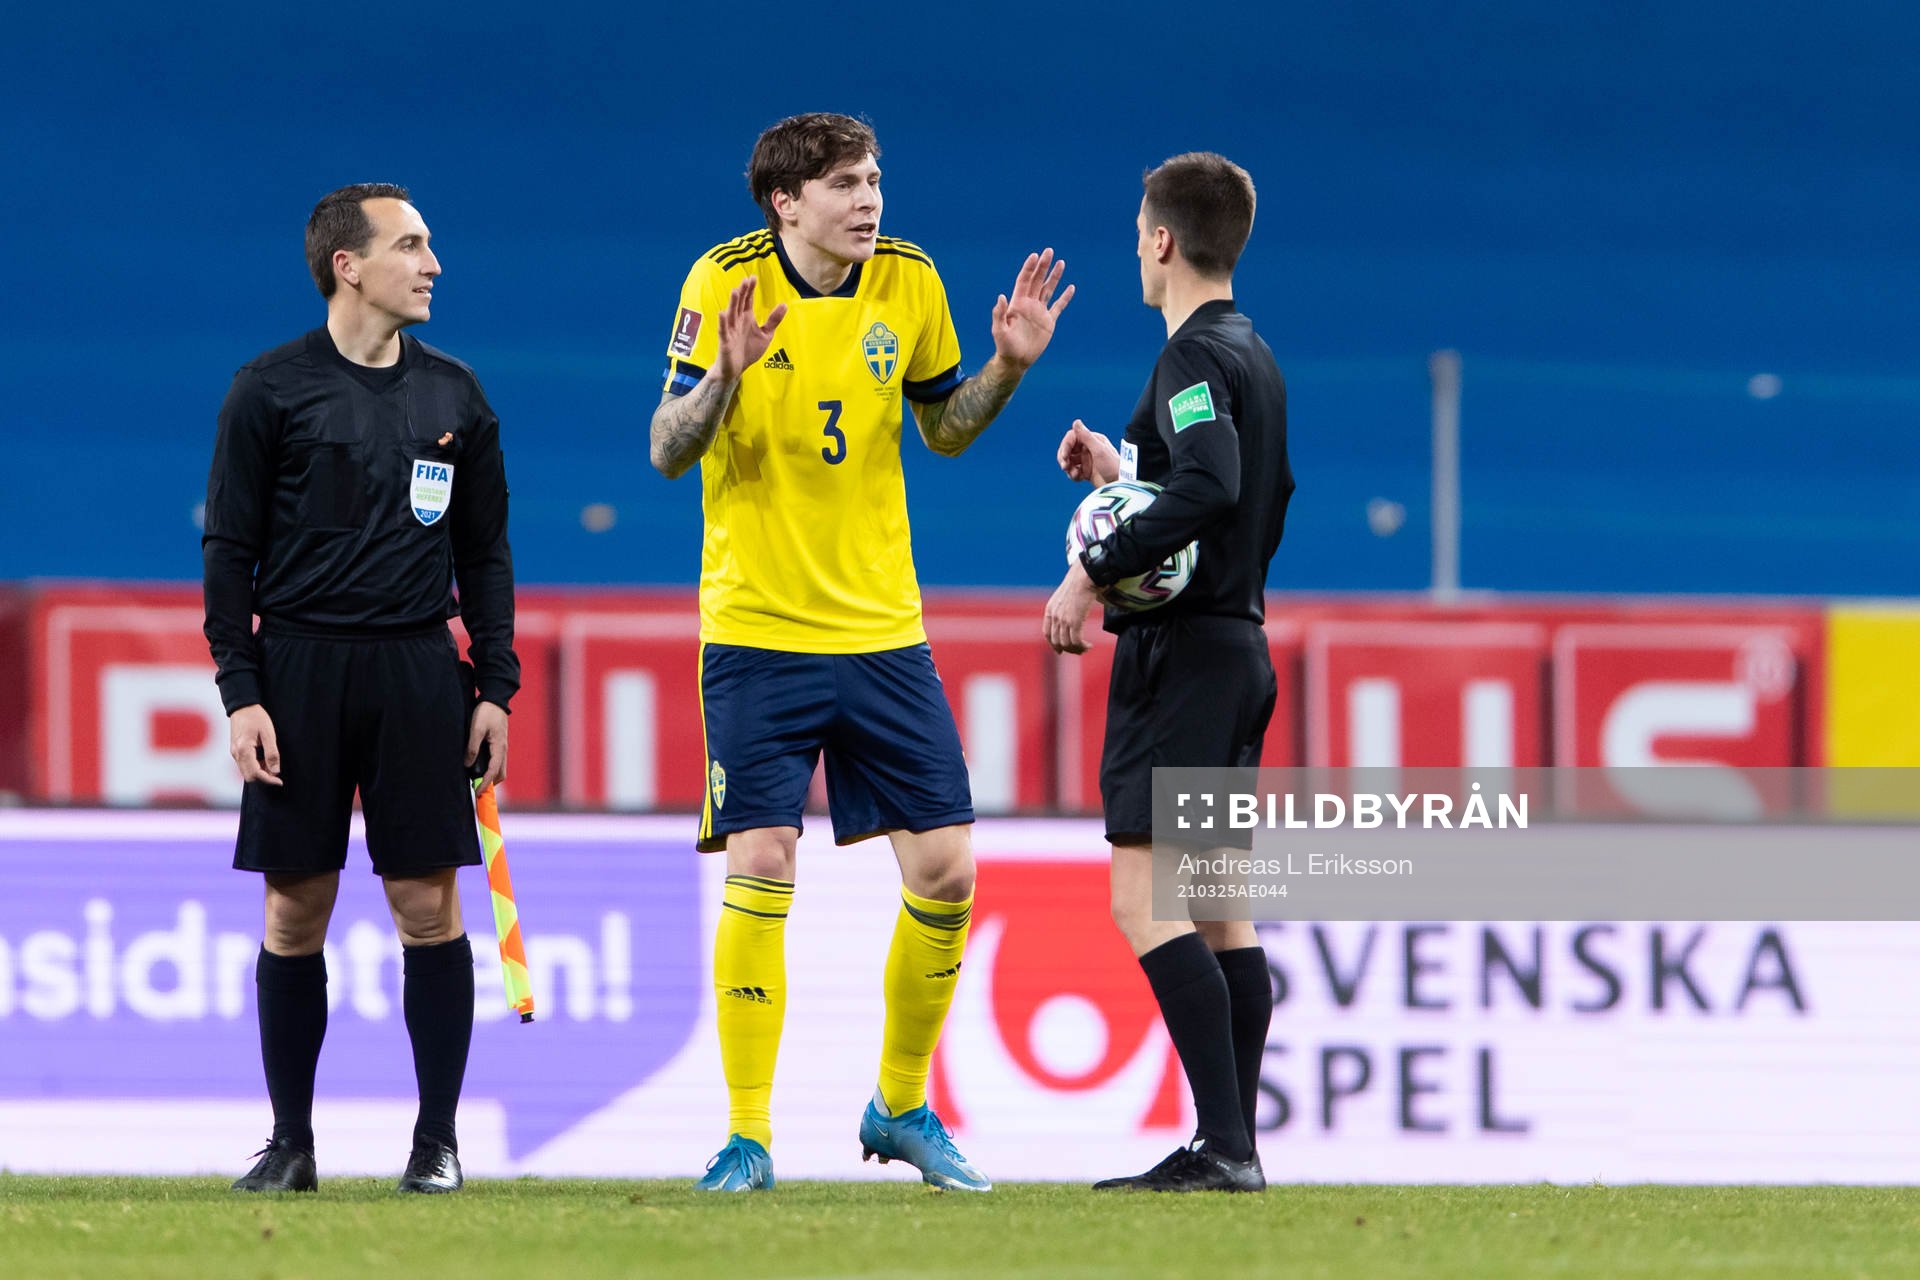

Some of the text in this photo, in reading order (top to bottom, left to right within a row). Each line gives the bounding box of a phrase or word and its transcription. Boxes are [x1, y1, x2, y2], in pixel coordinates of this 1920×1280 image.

[764, 361, 794, 371] adidas
[818, 400, 847, 465] 3
[416, 464, 448, 482] FIFA
[420, 509, 436, 520] 2021
[1254, 923, 1808, 1013] SVENSKA
[725, 990, 773, 1005] adidas
[1254, 1044, 1532, 1135] SPEL
